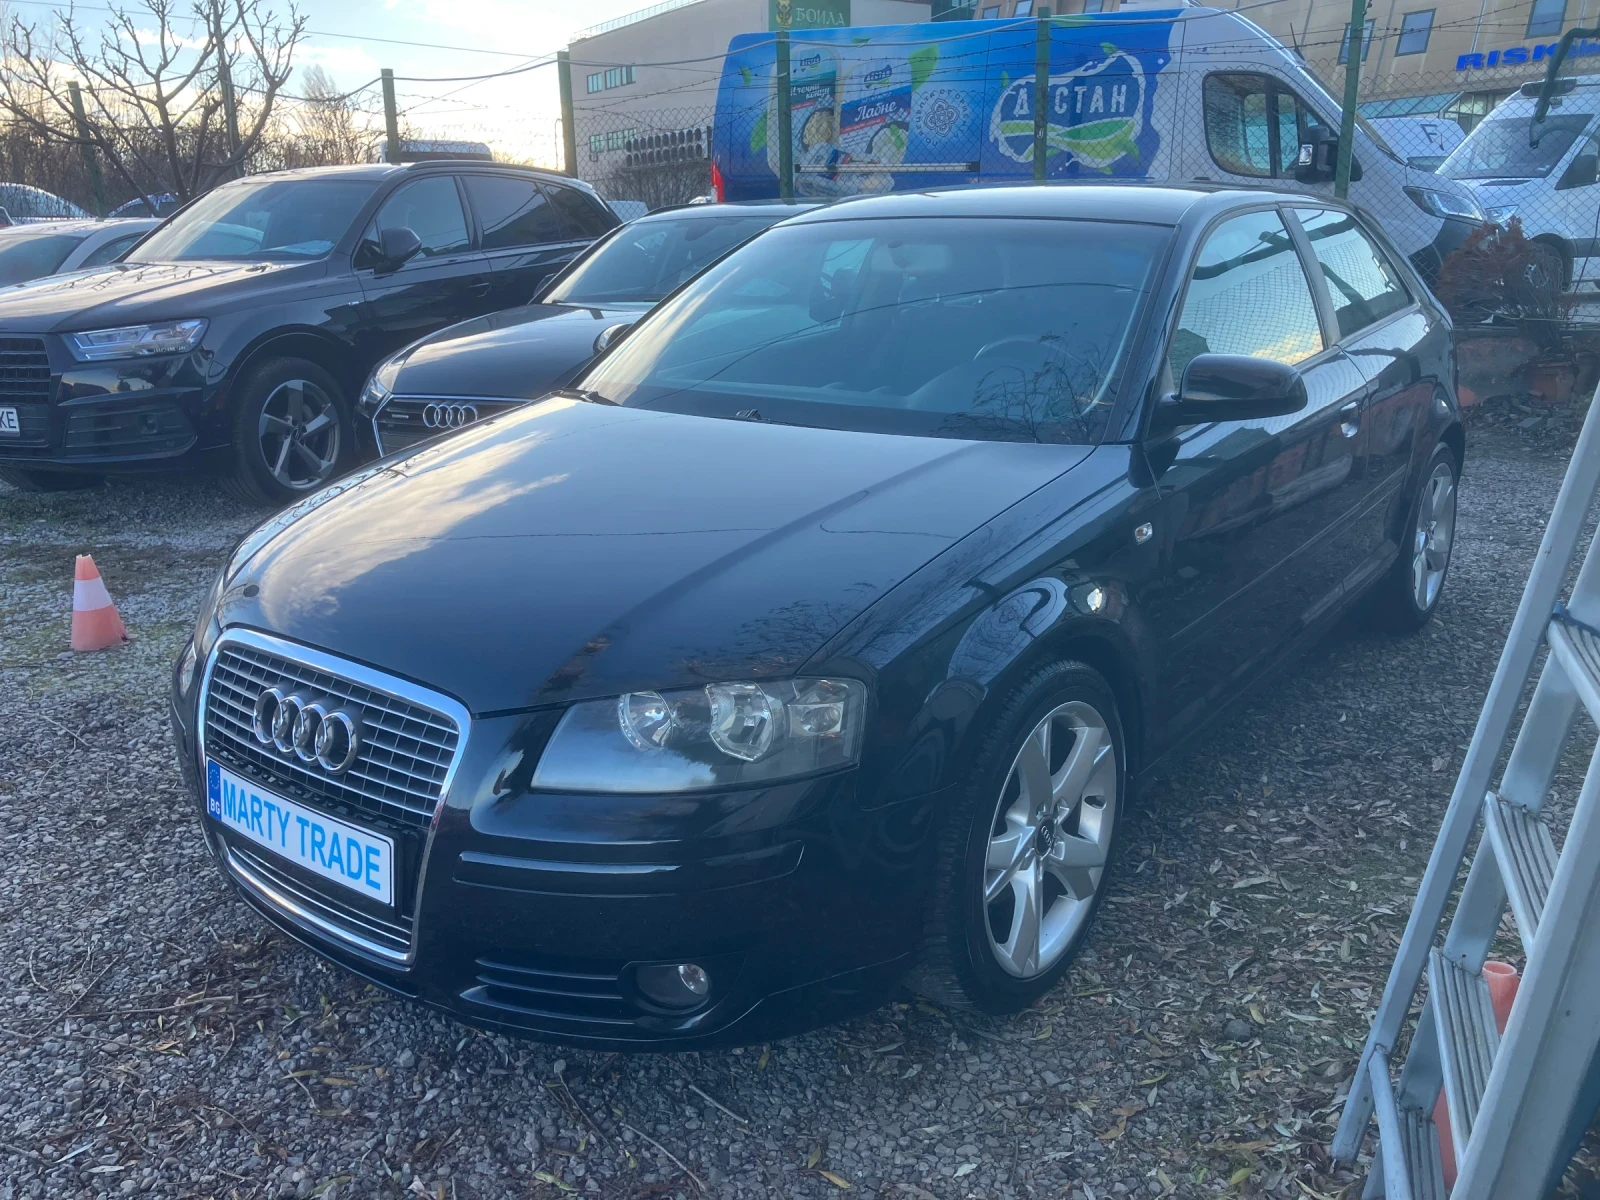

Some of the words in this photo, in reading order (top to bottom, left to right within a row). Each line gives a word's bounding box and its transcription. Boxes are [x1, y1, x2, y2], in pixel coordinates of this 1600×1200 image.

[854, 101, 897, 121] Лабне
[1013, 85, 1127, 117] ДСТАН
[209, 797, 221, 815] BG
[222, 779, 291, 848] MARTY
[296, 816, 381, 891] TRADE
